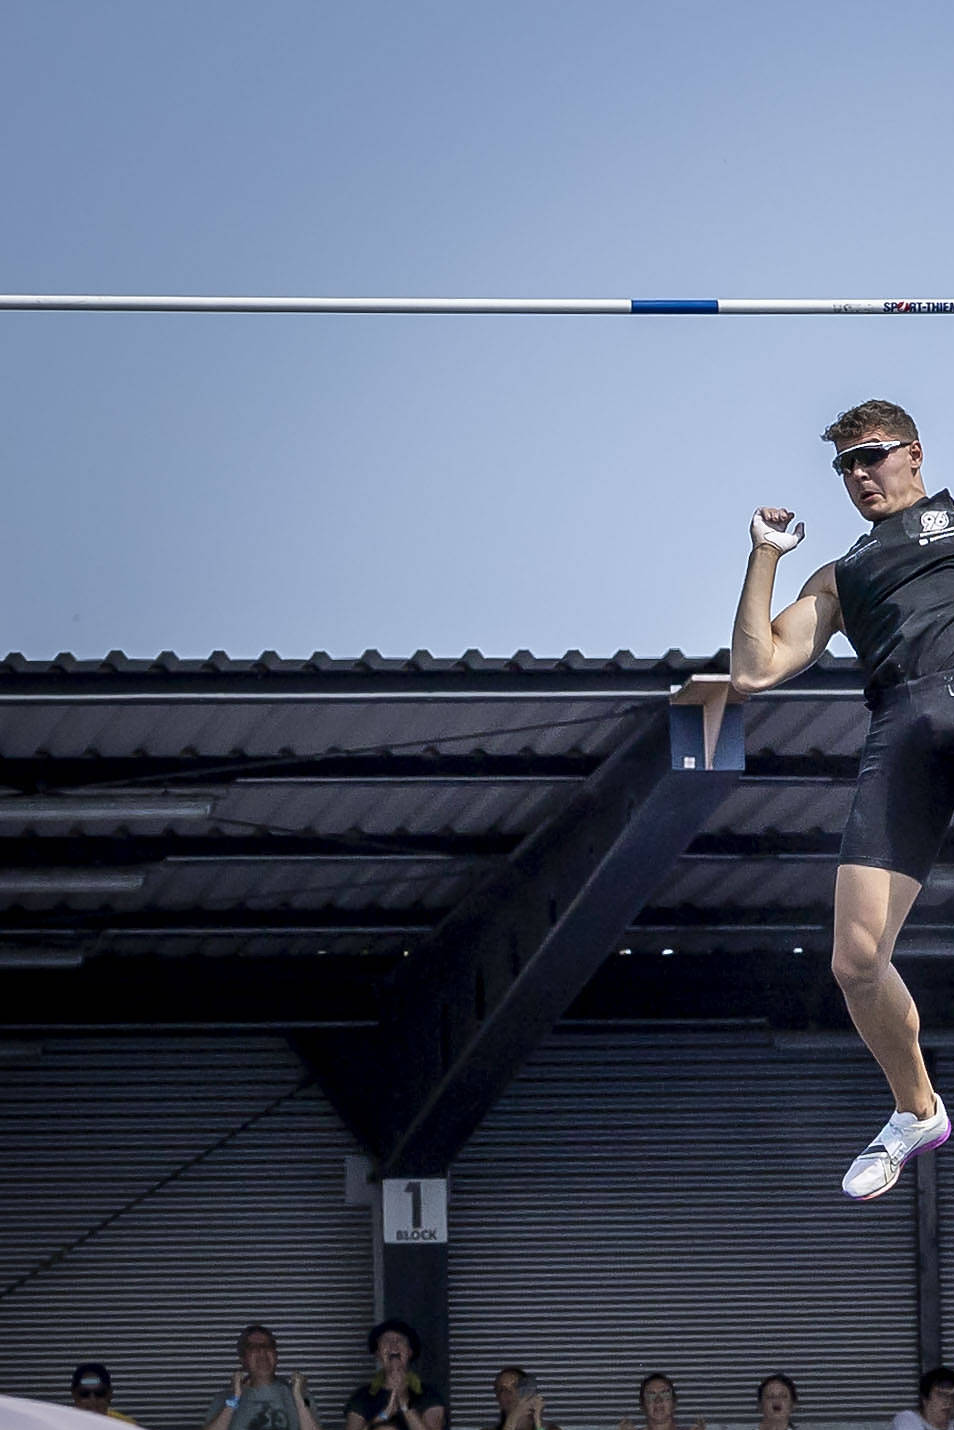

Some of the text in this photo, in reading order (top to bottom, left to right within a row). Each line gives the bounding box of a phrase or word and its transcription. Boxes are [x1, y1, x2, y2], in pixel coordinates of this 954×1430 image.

[920, 511, 949, 532] 96
[404, 1182, 421, 1228] 1
[396, 1230, 437, 1240] BLOCK
